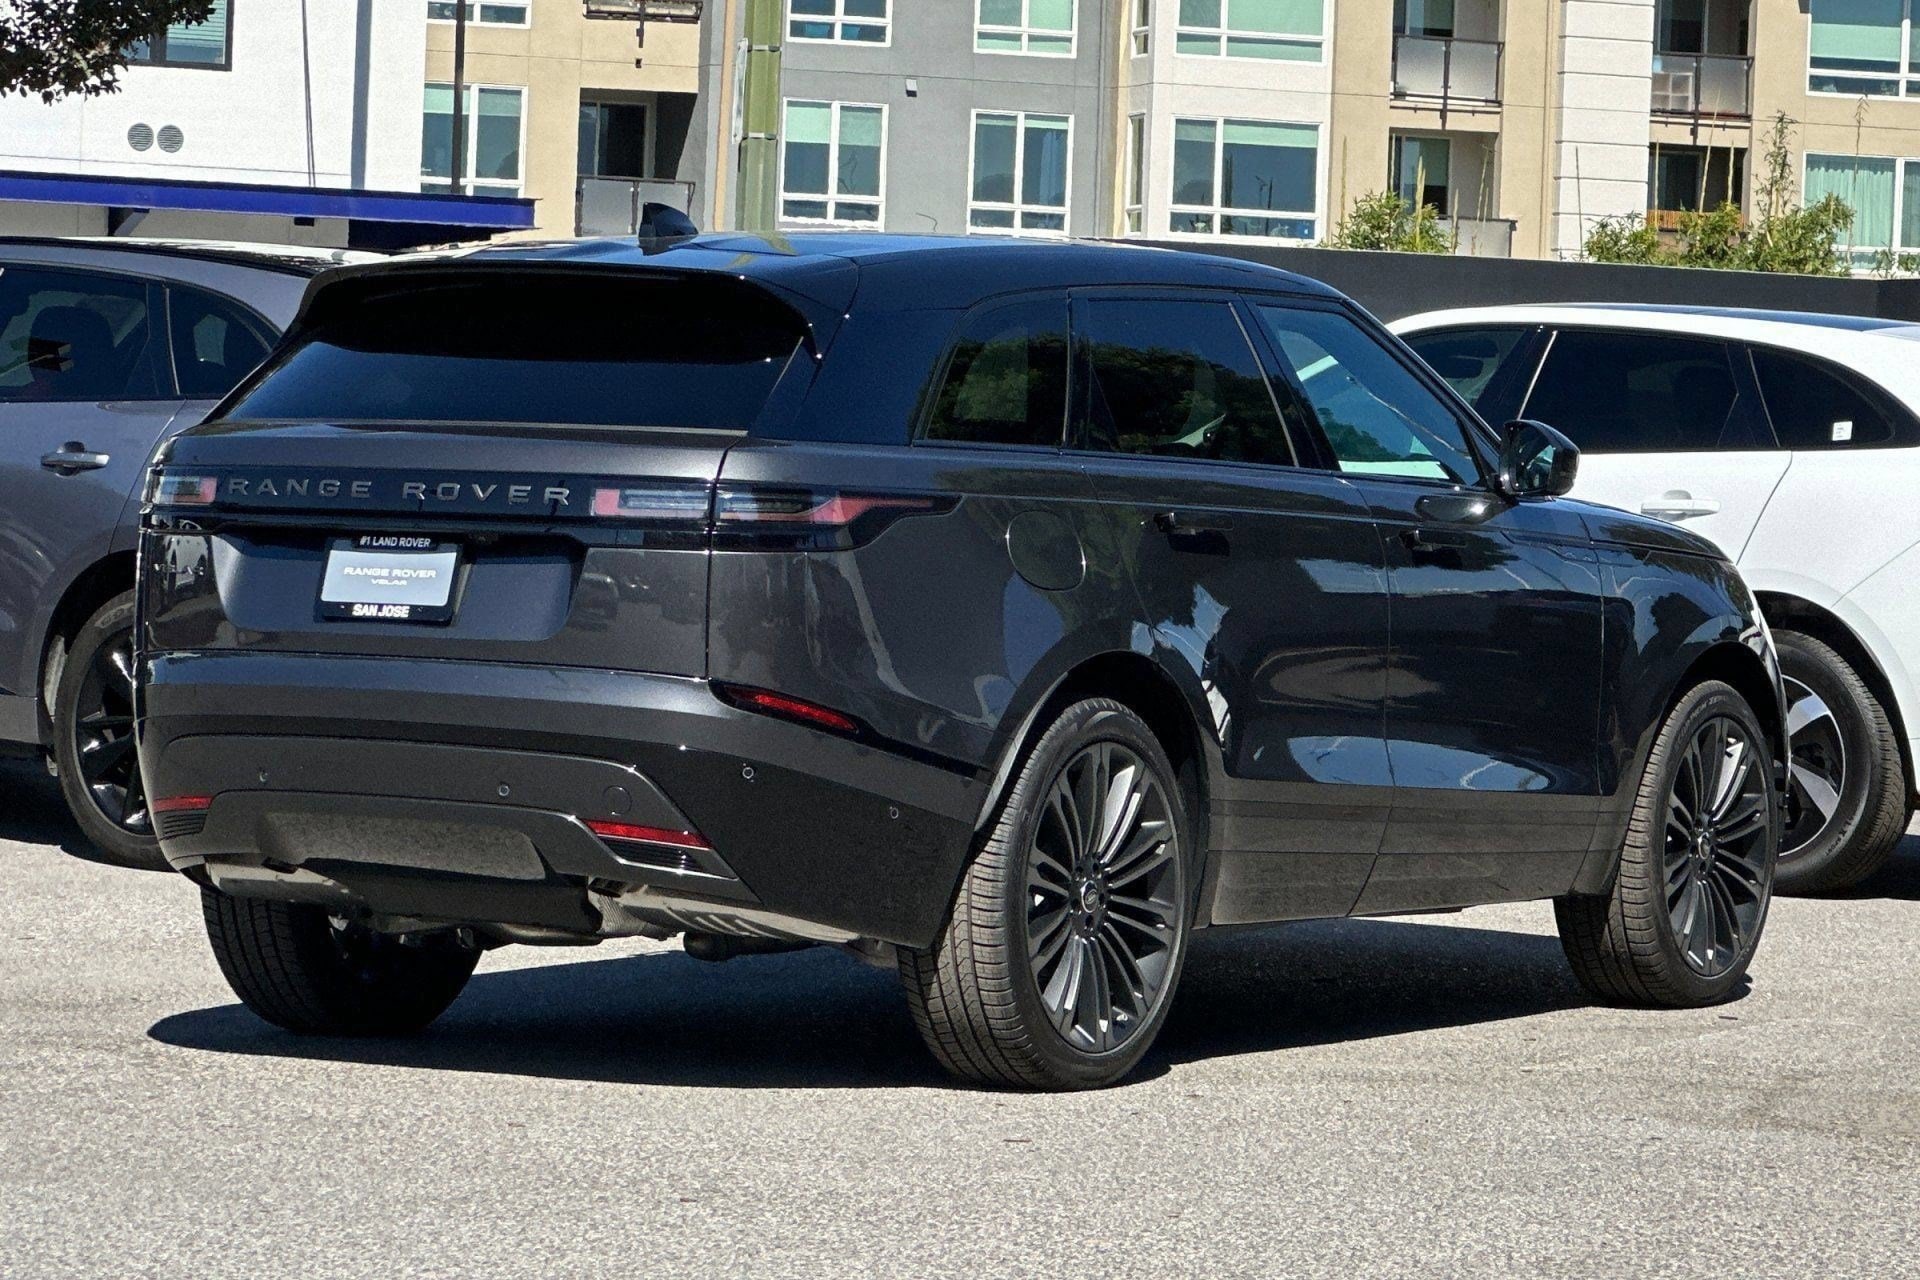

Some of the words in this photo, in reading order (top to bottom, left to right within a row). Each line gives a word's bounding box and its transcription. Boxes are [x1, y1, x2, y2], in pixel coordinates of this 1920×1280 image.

[228, 478, 372, 499] RANGE
[402, 482, 570, 506] ROVER
[360, 536, 371, 546] #1
[372, 537, 398, 547] LAND
[399, 537, 431, 548] ROVER
[344, 567, 389, 577] RANGE
[392, 569, 436, 578] ROVER
[352, 604, 377, 616] SAN
[378, 606, 411, 618] JOSE
